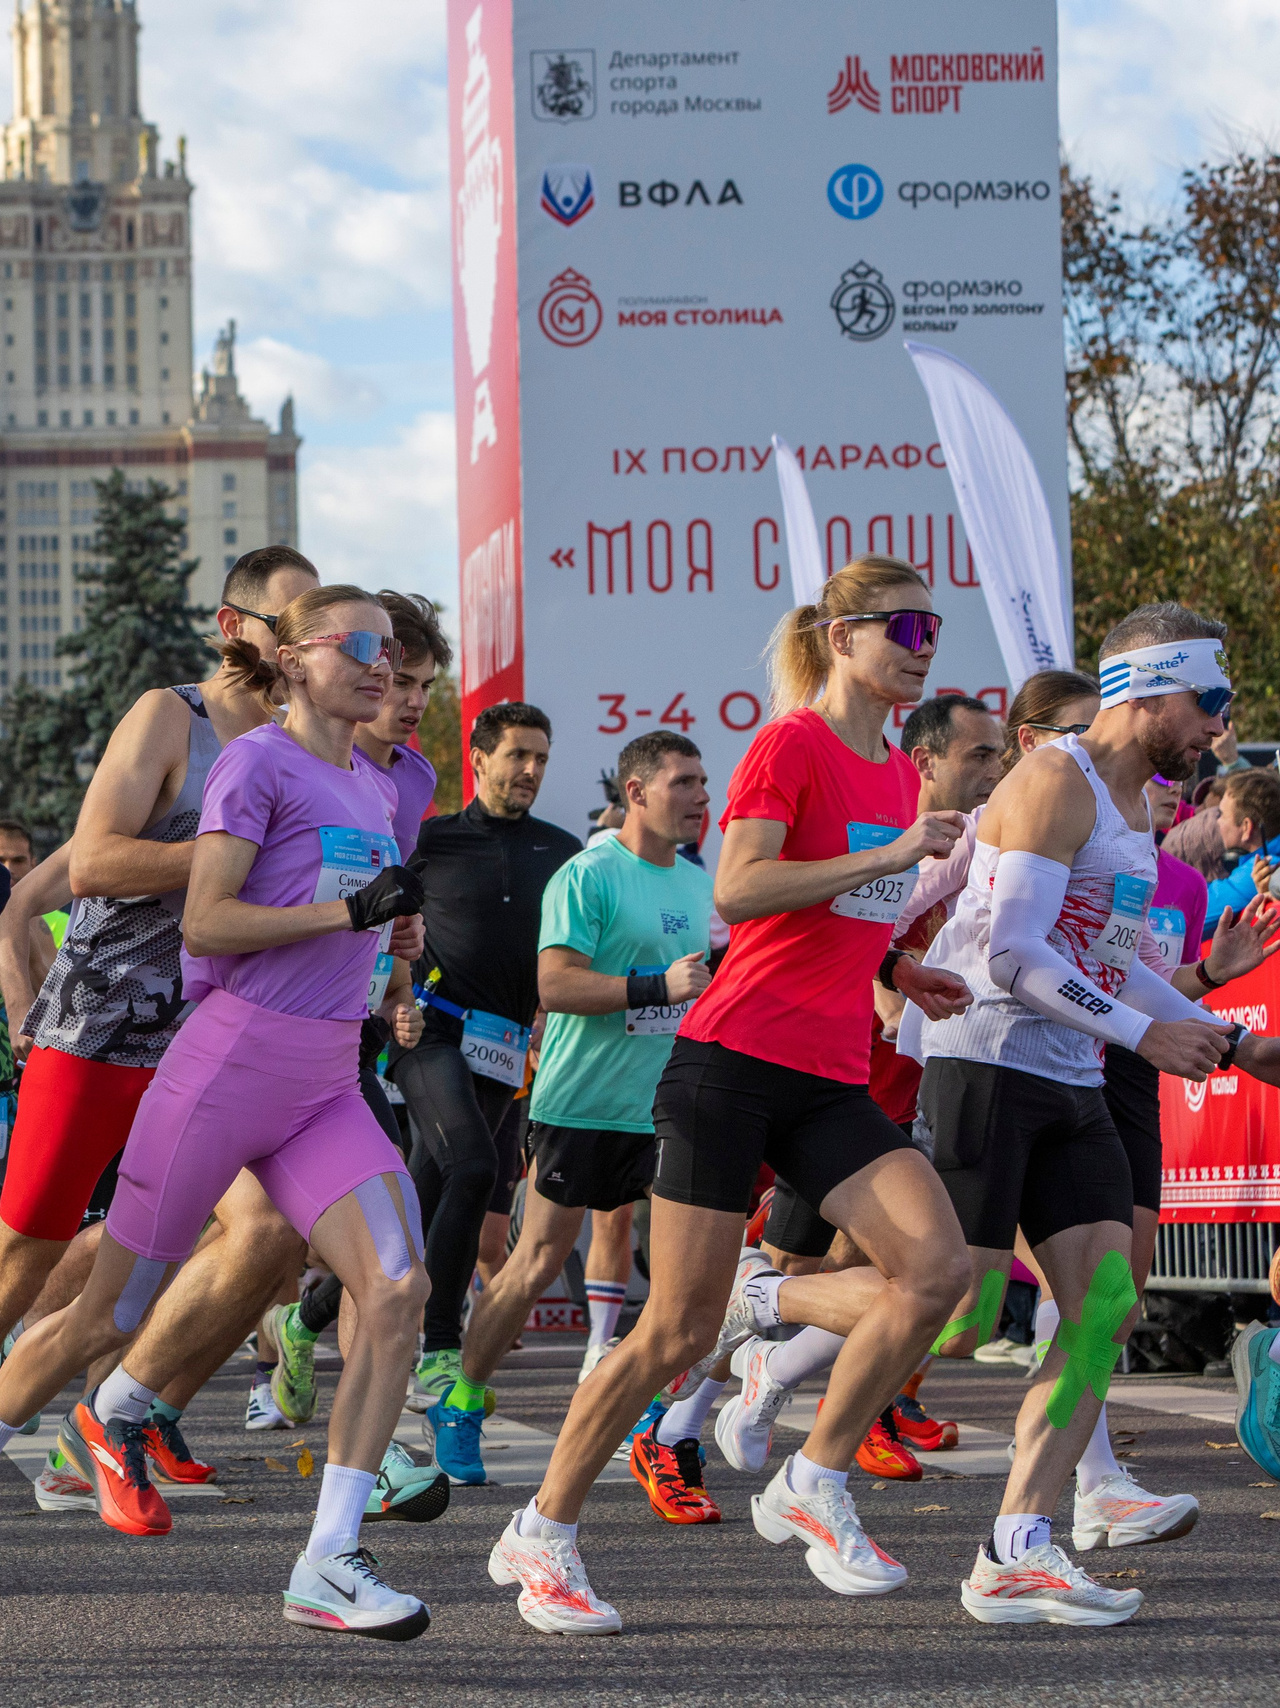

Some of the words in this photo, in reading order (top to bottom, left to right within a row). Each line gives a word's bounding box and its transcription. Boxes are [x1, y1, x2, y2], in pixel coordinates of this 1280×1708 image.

[609, 49, 740, 71] Департамент
[890, 46, 1045, 82] МОСКОВСКИЙ
[610, 75, 678, 94] спорта
[610, 98, 679, 118] города
[684, 96, 762, 112] Москвы
[891, 85, 963, 114] СПОРТ
[619, 179, 744, 207] ВФЛА
[898, 180, 1051, 209] фармэко
[902, 280, 1023, 302] фармэко
[618, 310, 668, 327] МОЯ
[673, 307, 784, 327] СТОЛИЦА
[949, 303, 969, 315] ПО
[598, 690, 697, 734] 3-4
[876, 813, 899, 827] MOAX
[338, 873, 372, 889] Сима
[465, 1042, 514, 1071] 20096
